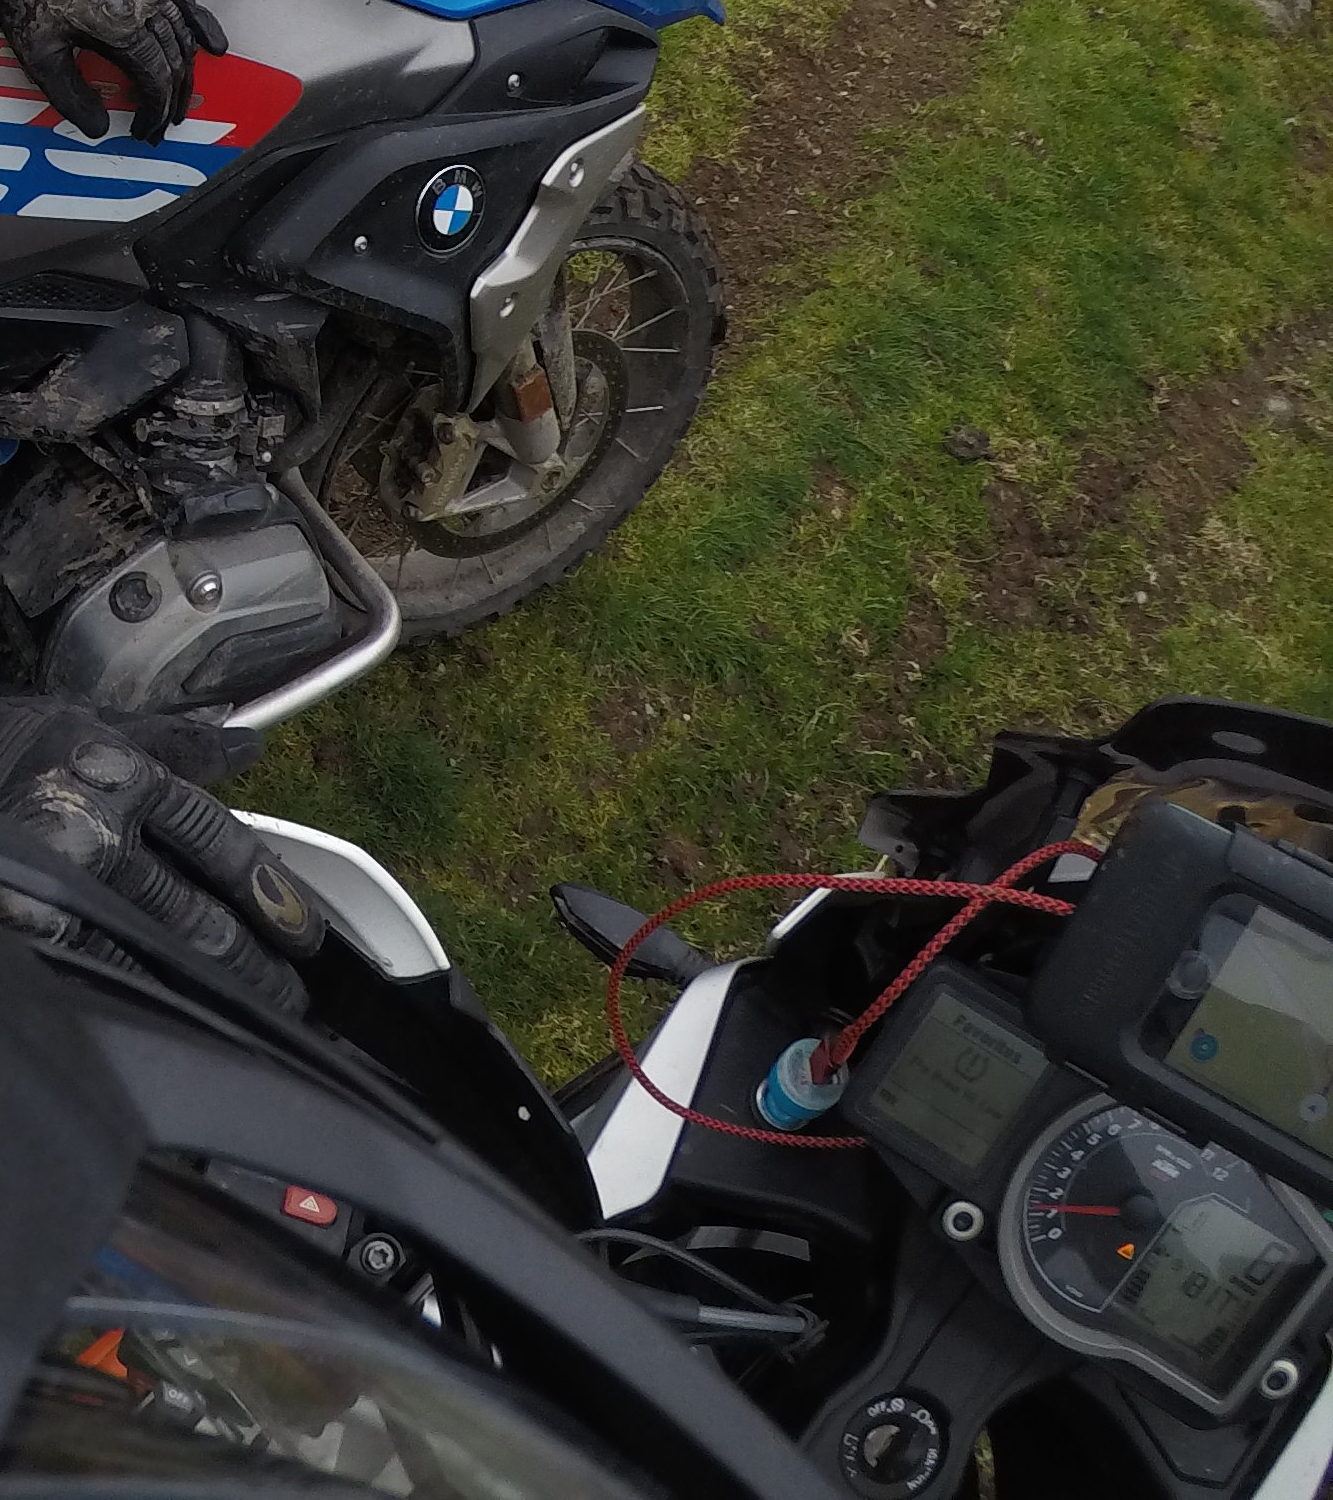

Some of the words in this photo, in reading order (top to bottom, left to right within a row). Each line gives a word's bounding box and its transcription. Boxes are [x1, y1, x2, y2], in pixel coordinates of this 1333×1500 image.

[1107, 1123, 1123, 1136] 6
[1085, 1132, 1102, 1145] 5
[1070, 1149, 1084, 1161] 4
[1056, 1166, 1072, 1179] 3
[1047, 1187, 1065, 1200] 2
[1046, 1227, 1063, 1240] 0
